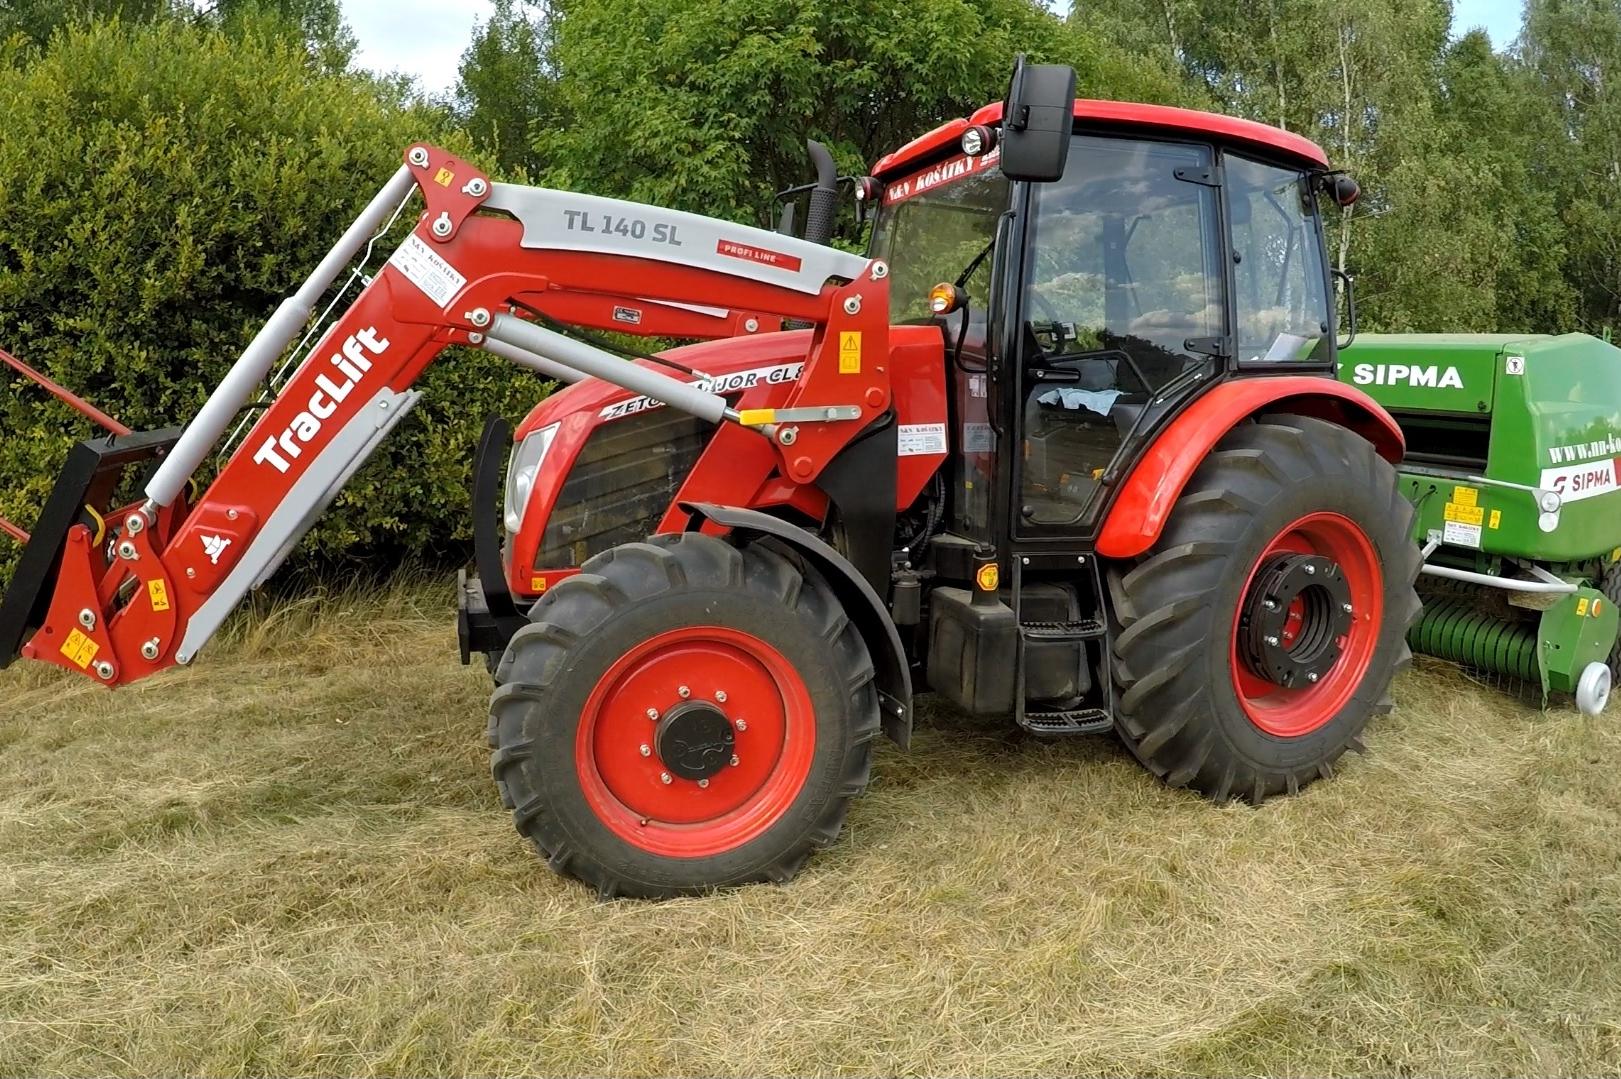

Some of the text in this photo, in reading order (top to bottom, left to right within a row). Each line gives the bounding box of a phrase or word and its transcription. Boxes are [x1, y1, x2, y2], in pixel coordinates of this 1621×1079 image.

[563, 209, 682, 246] TL 140 SL
[724, 244, 777, 263] PROFI LINE
[1353, 363, 1464, 390] SIPMA
[253, 326, 391, 474] TracLift
[1572, 468, 1611, 492] SIPMA
